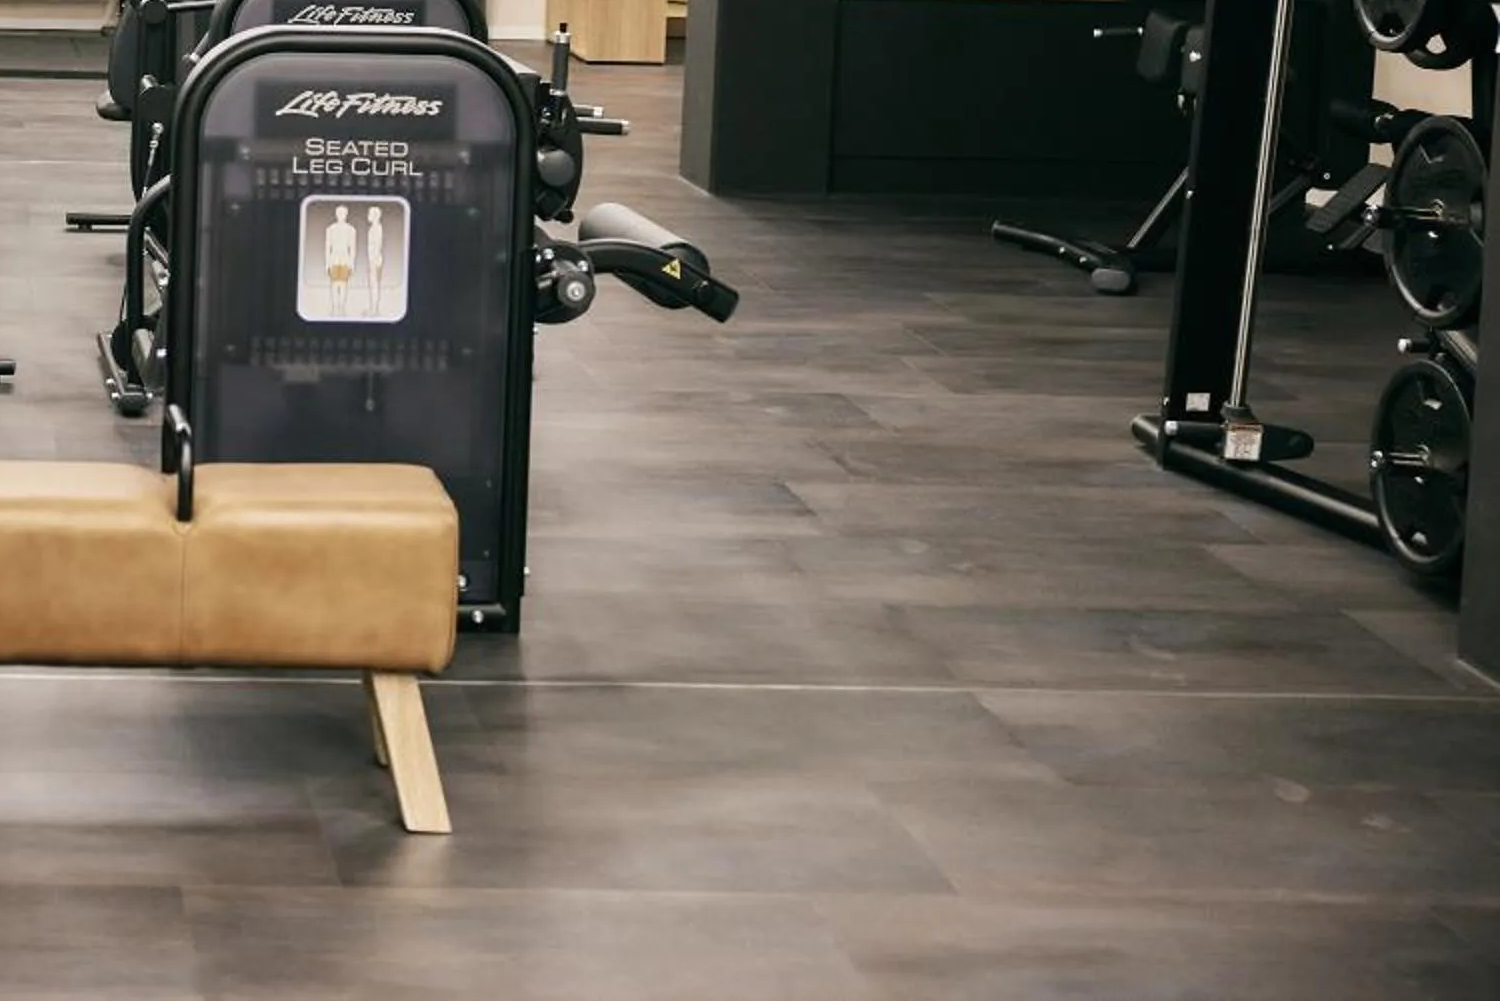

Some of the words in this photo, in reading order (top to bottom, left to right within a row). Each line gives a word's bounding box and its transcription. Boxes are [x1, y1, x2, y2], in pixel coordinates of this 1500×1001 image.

[287, 4, 337, 25] Life
[334, 6, 415, 27] Fitness
[275, 90, 340, 118] Life
[335, 92, 443, 119] Fitness
[304, 137, 409, 158] SEATED
[292, 156, 343, 175] LEG
[350, 156, 424, 177] CURL
